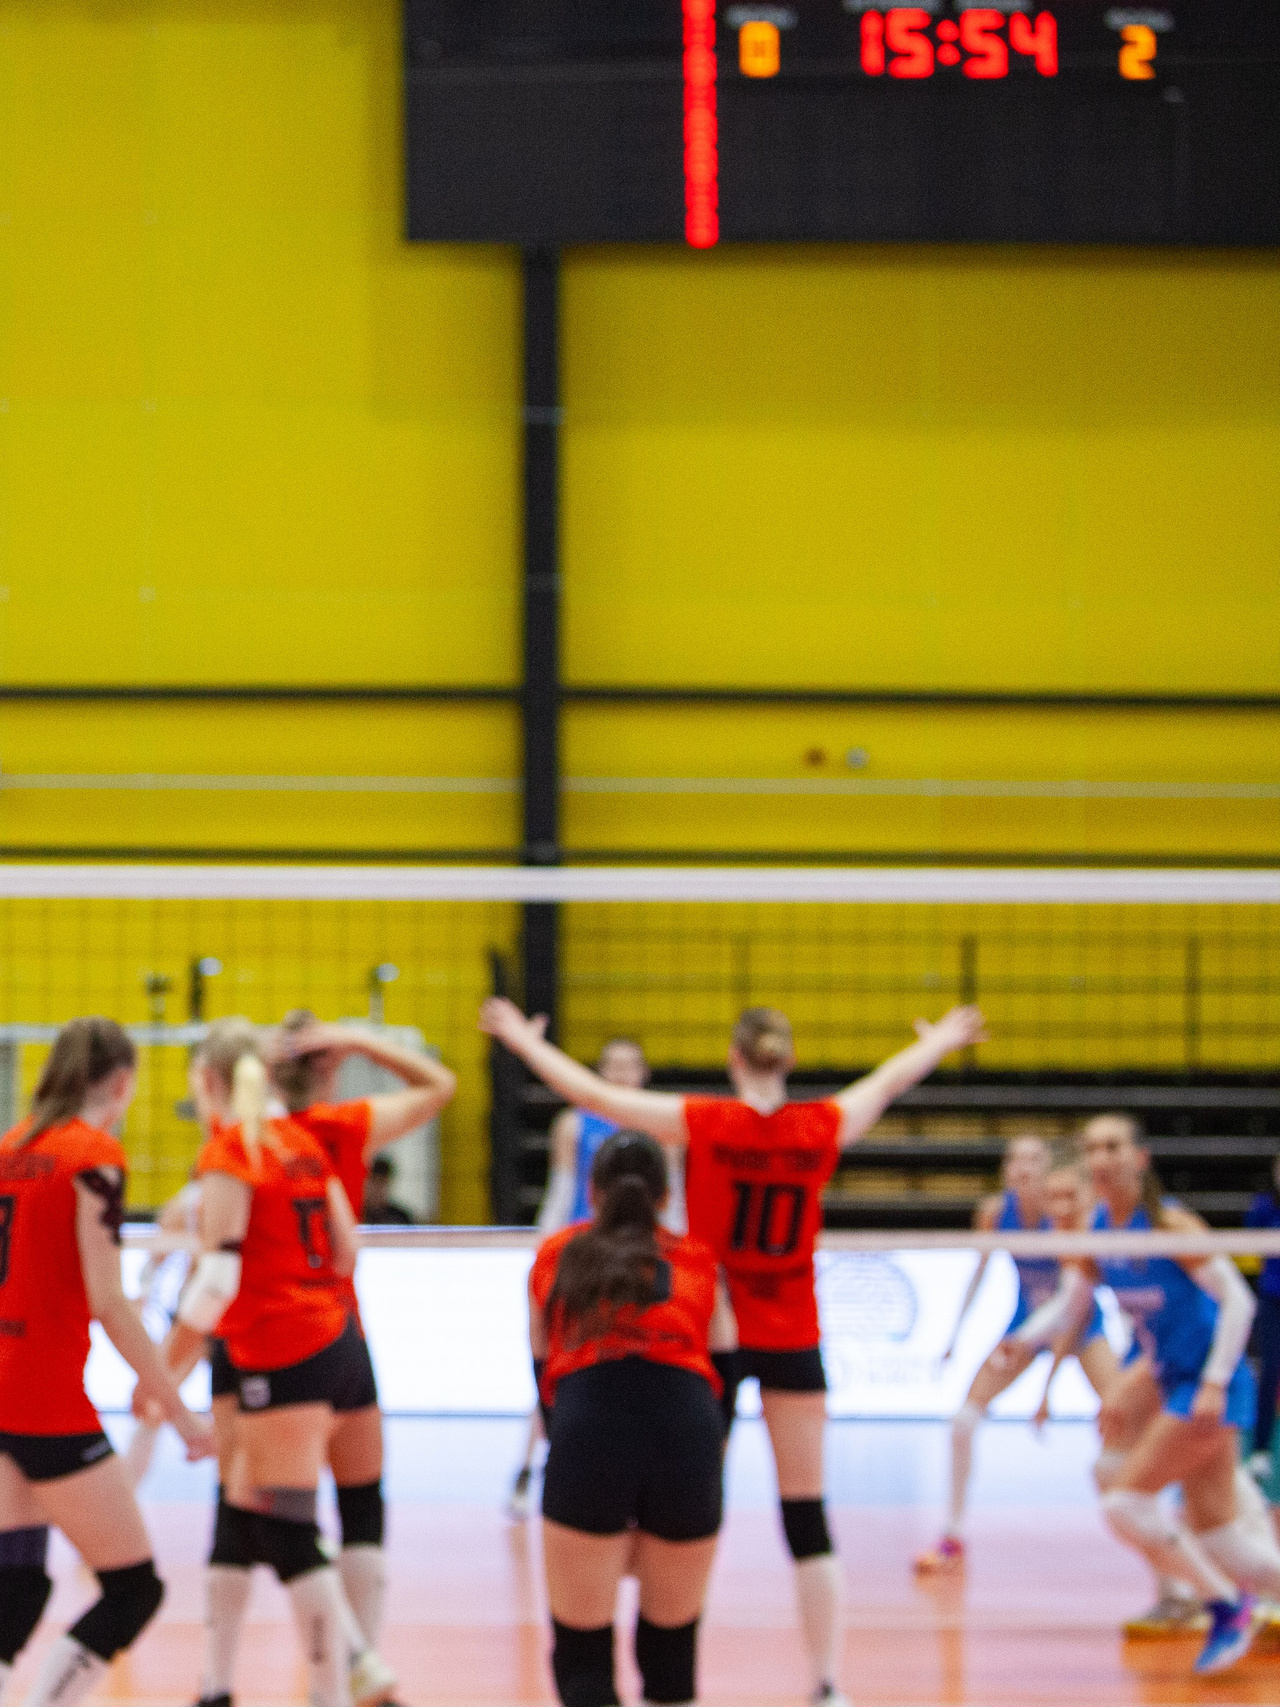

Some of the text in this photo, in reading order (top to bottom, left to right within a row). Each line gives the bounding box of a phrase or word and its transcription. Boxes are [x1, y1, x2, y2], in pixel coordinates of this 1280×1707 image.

[859, 8, 1059, 80] 15:54
[1118, 23, 1157, 81] 2
[730, 1179, 808, 1257] 10
